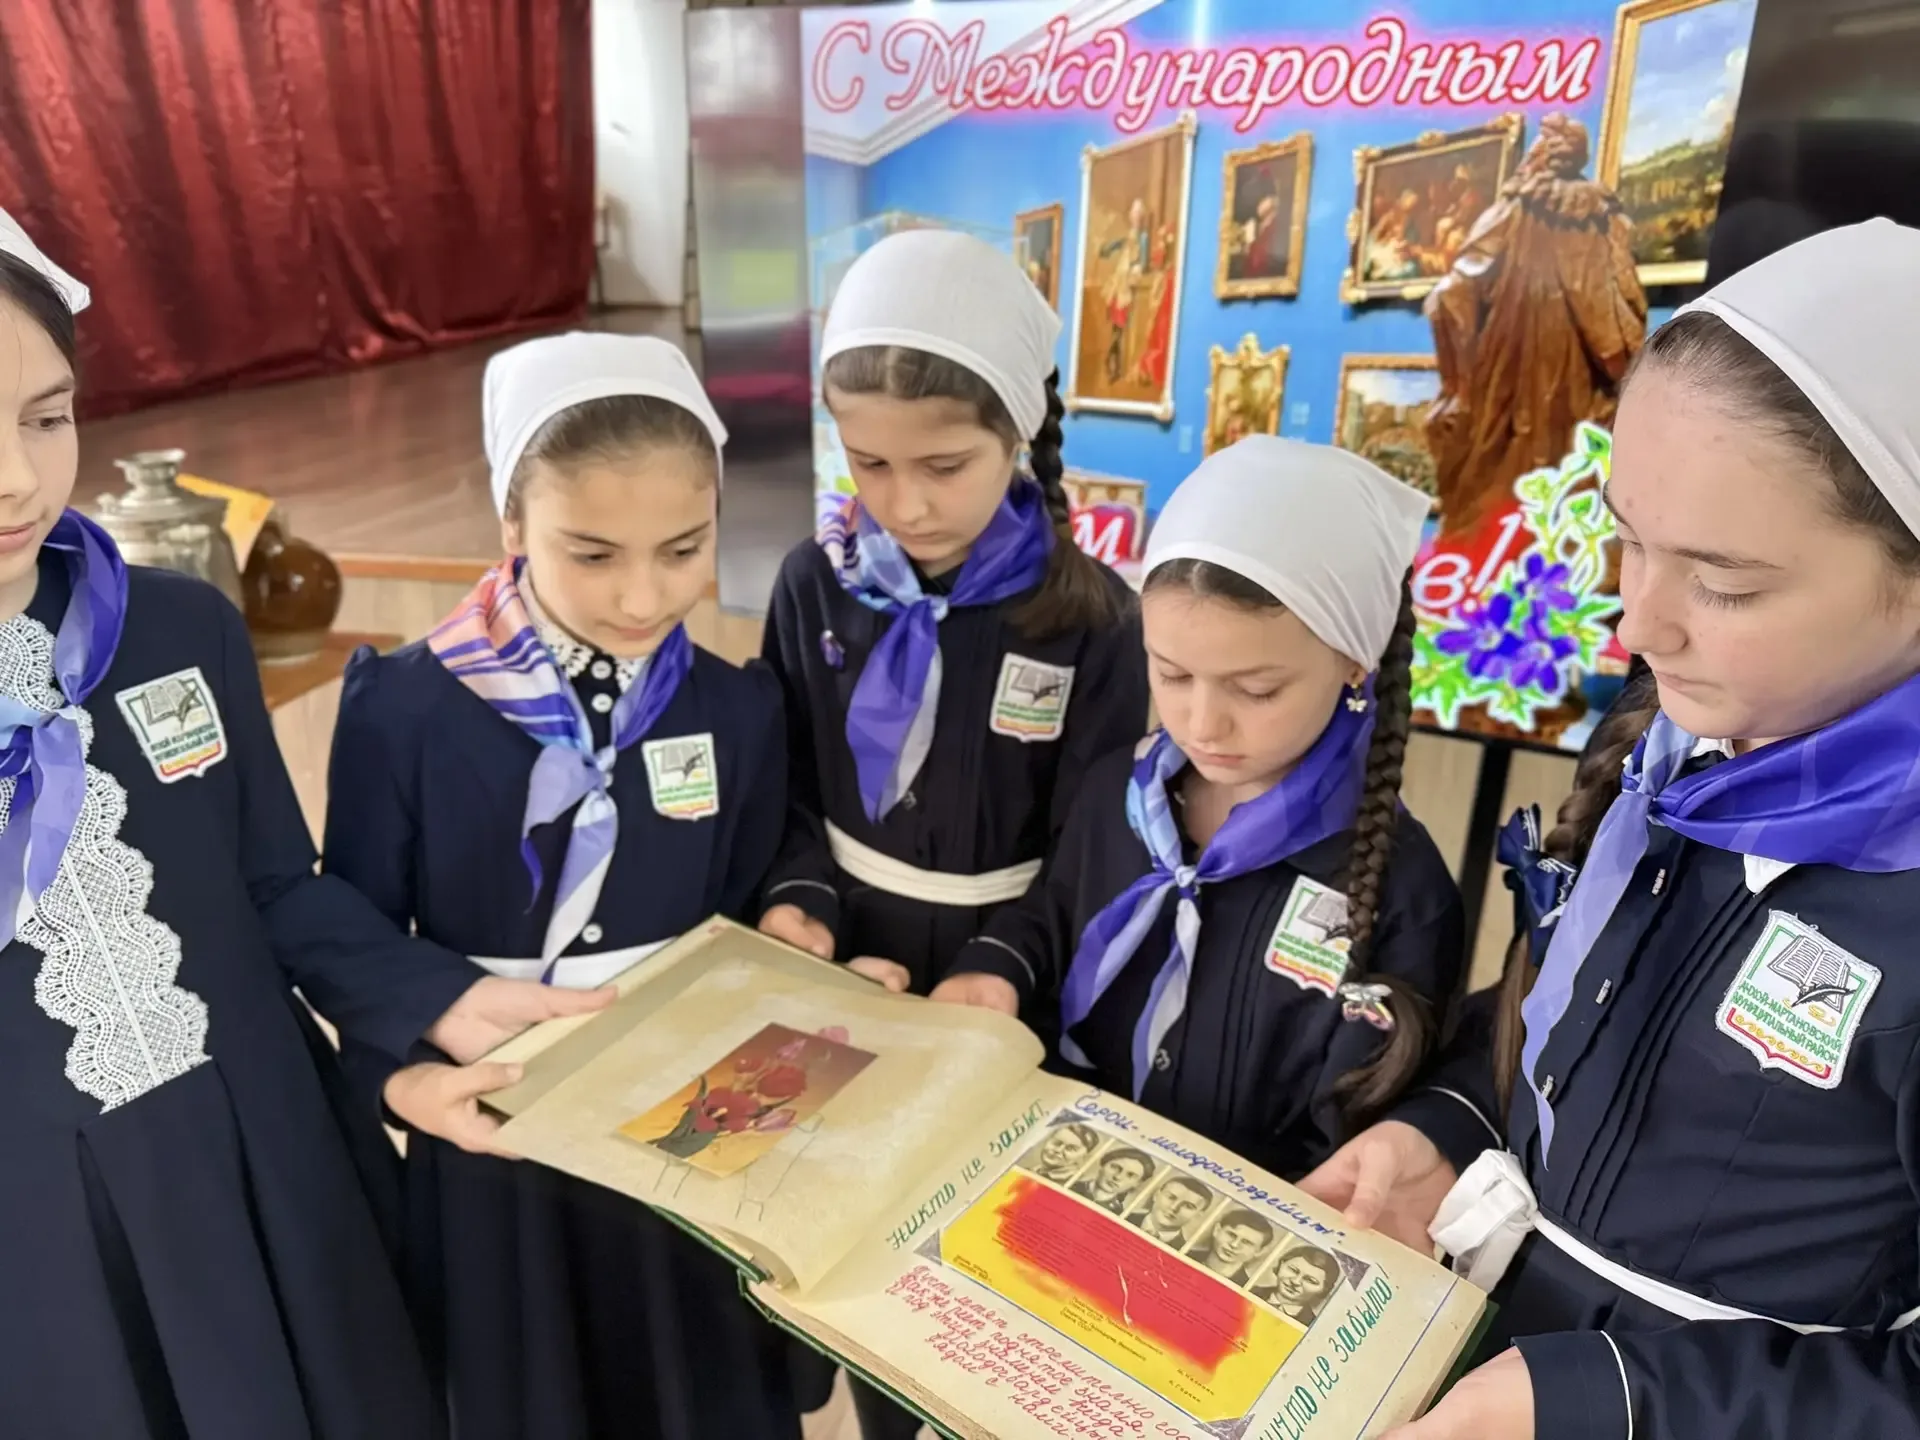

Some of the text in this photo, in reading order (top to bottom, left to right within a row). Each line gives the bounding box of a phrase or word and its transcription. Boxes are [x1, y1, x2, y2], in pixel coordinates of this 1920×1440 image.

[812, 14, 1600, 133] С Международным
[1805, 1039, 1840, 1065] РАЙОН
[960, 1157, 986, 1185] не
[1307, 1356, 1340, 1400] не
